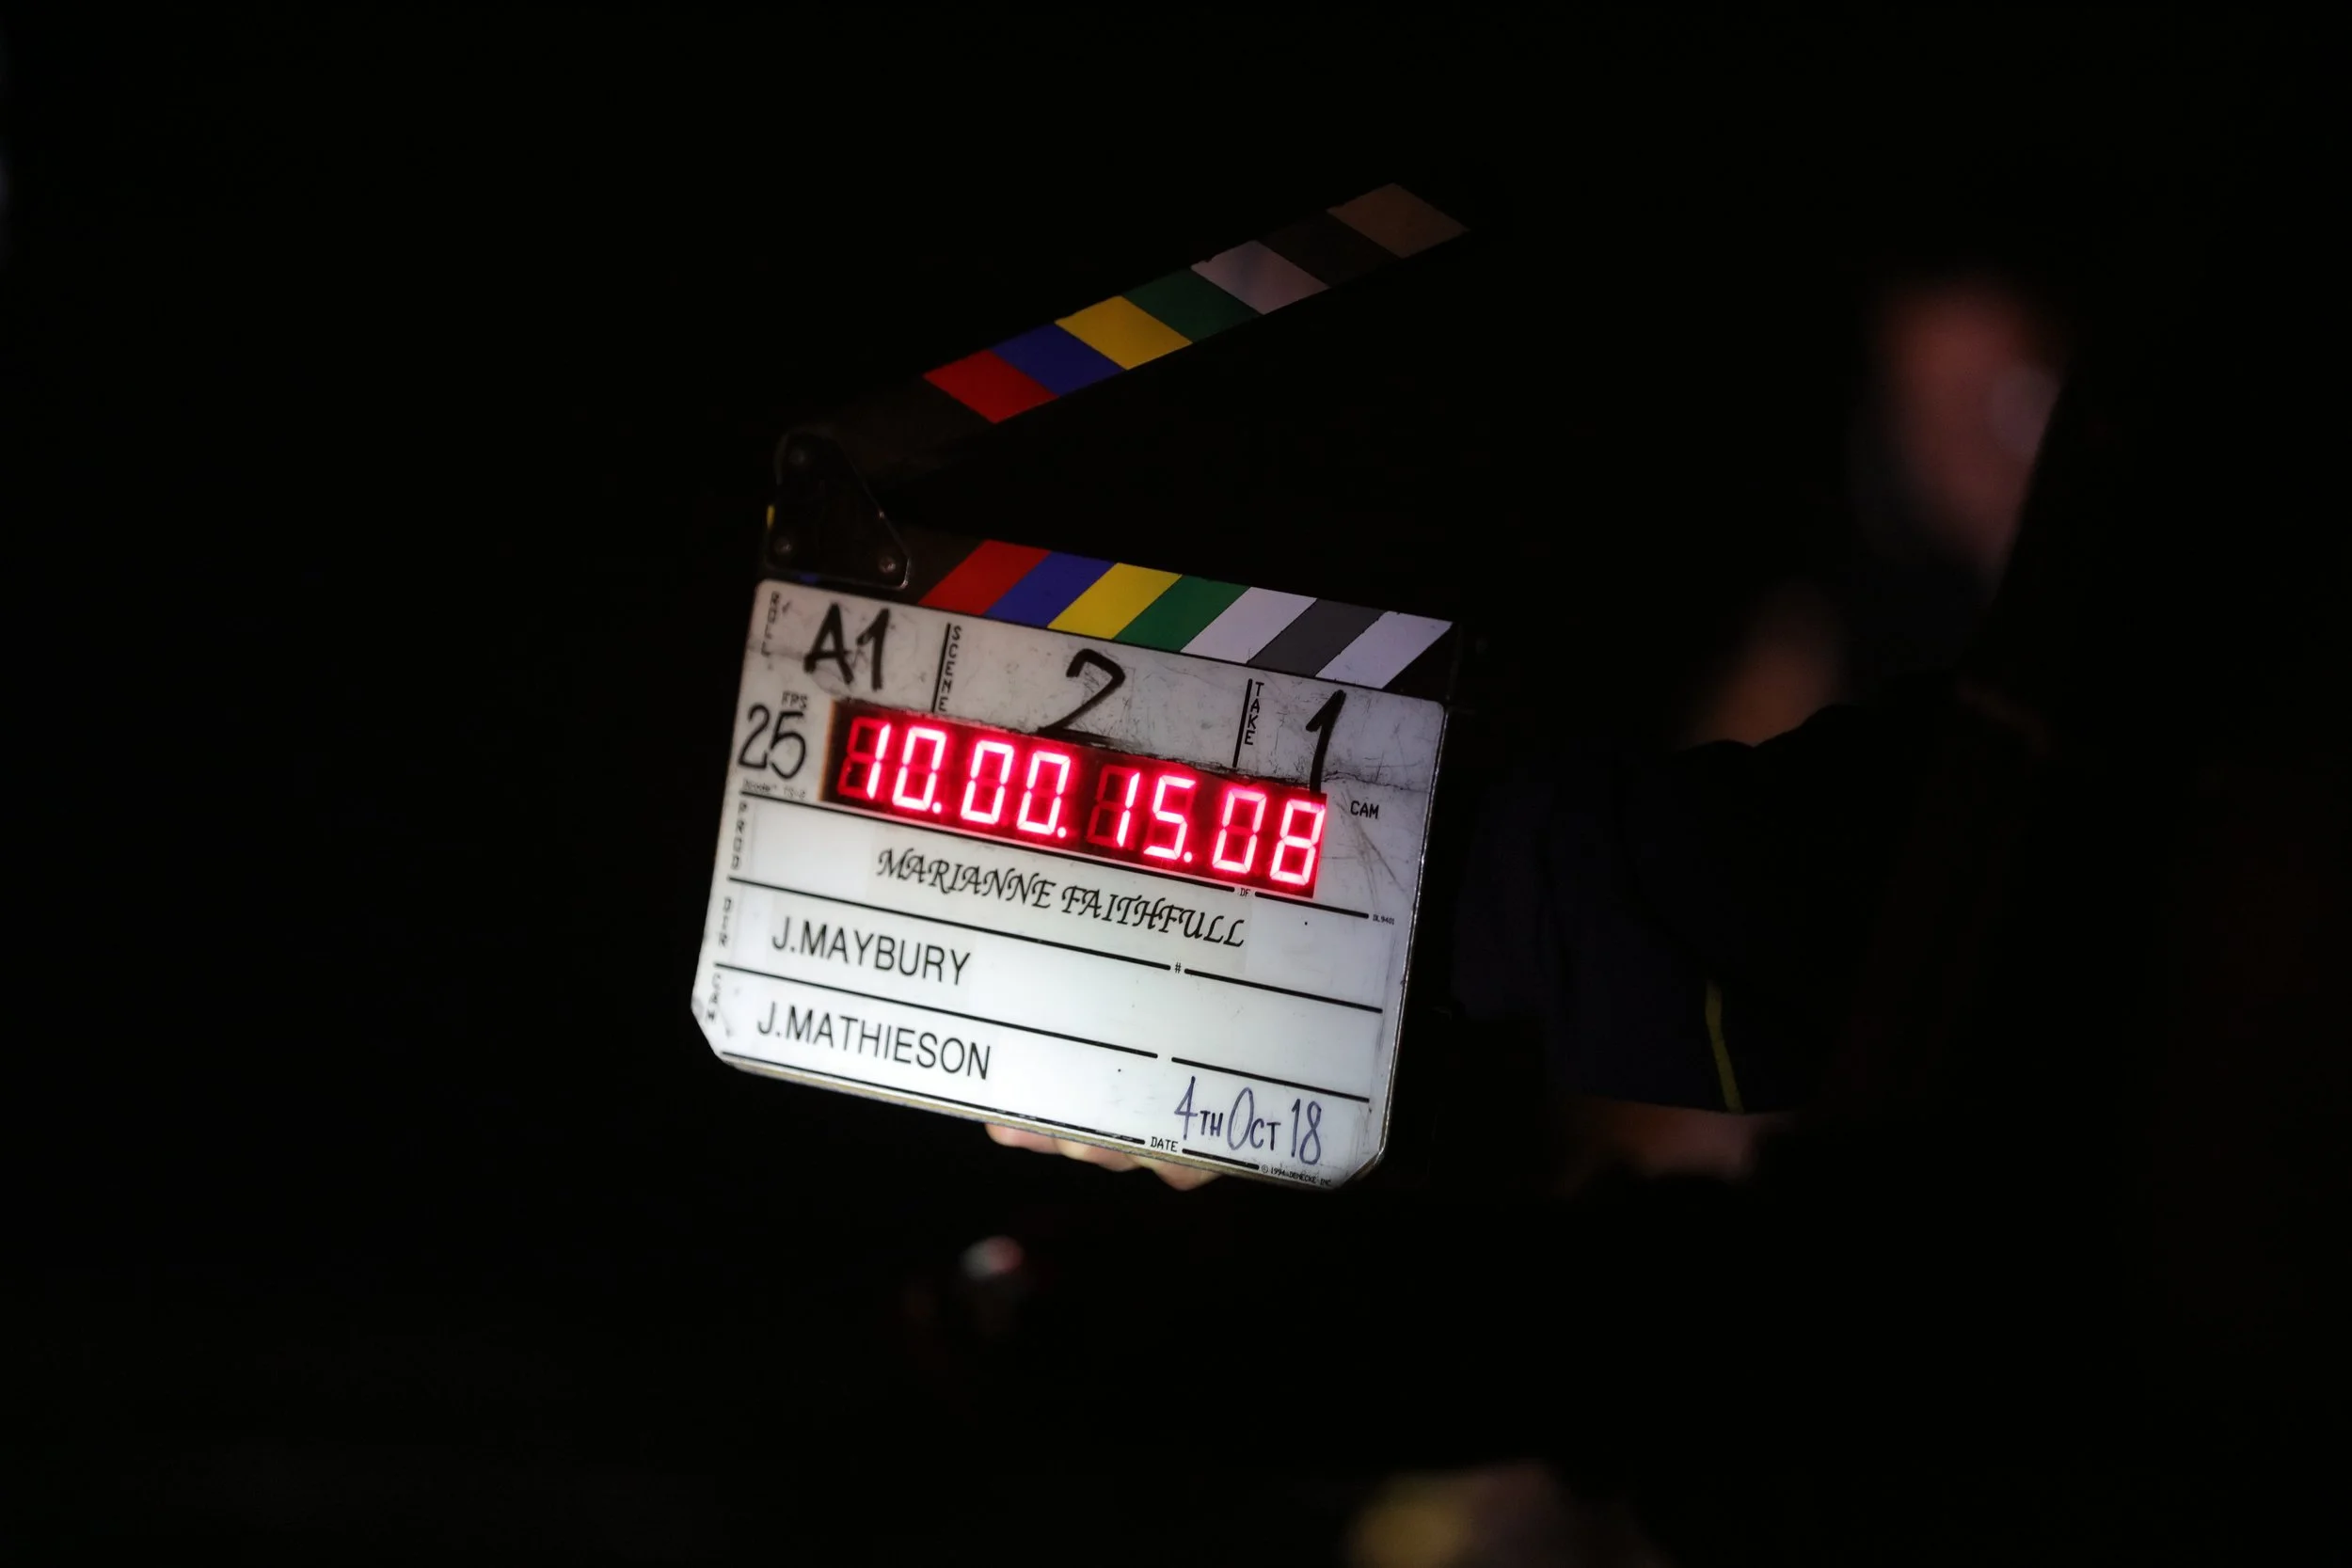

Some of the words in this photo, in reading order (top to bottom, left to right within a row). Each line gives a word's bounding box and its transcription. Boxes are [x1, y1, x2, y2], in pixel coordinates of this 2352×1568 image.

[803, 602, 891, 691] A1
[937, 625, 962, 712] SCENE
[781, 689, 808, 709] FPS
[1036, 647, 1127, 747] 2
[1243, 680, 1265, 746] TAKE
[738, 704, 807, 780] 25
[1306, 689, 1347, 796] 1
[1350, 800, 1380, 820] CAM
[877, 847, 1057, 910] MARIANNE
[1061, 884, 1246, 949] FAITHFULL
[1239, 887, 1252, 897] DF
[771, 916, 971, 986] J.MAYBURY
[757, 1001, 991, 1081] J.MATHIESON
[1150, 1135, 1179, 1153] DATE
[1291, 1098, 1323, 1165] 18
